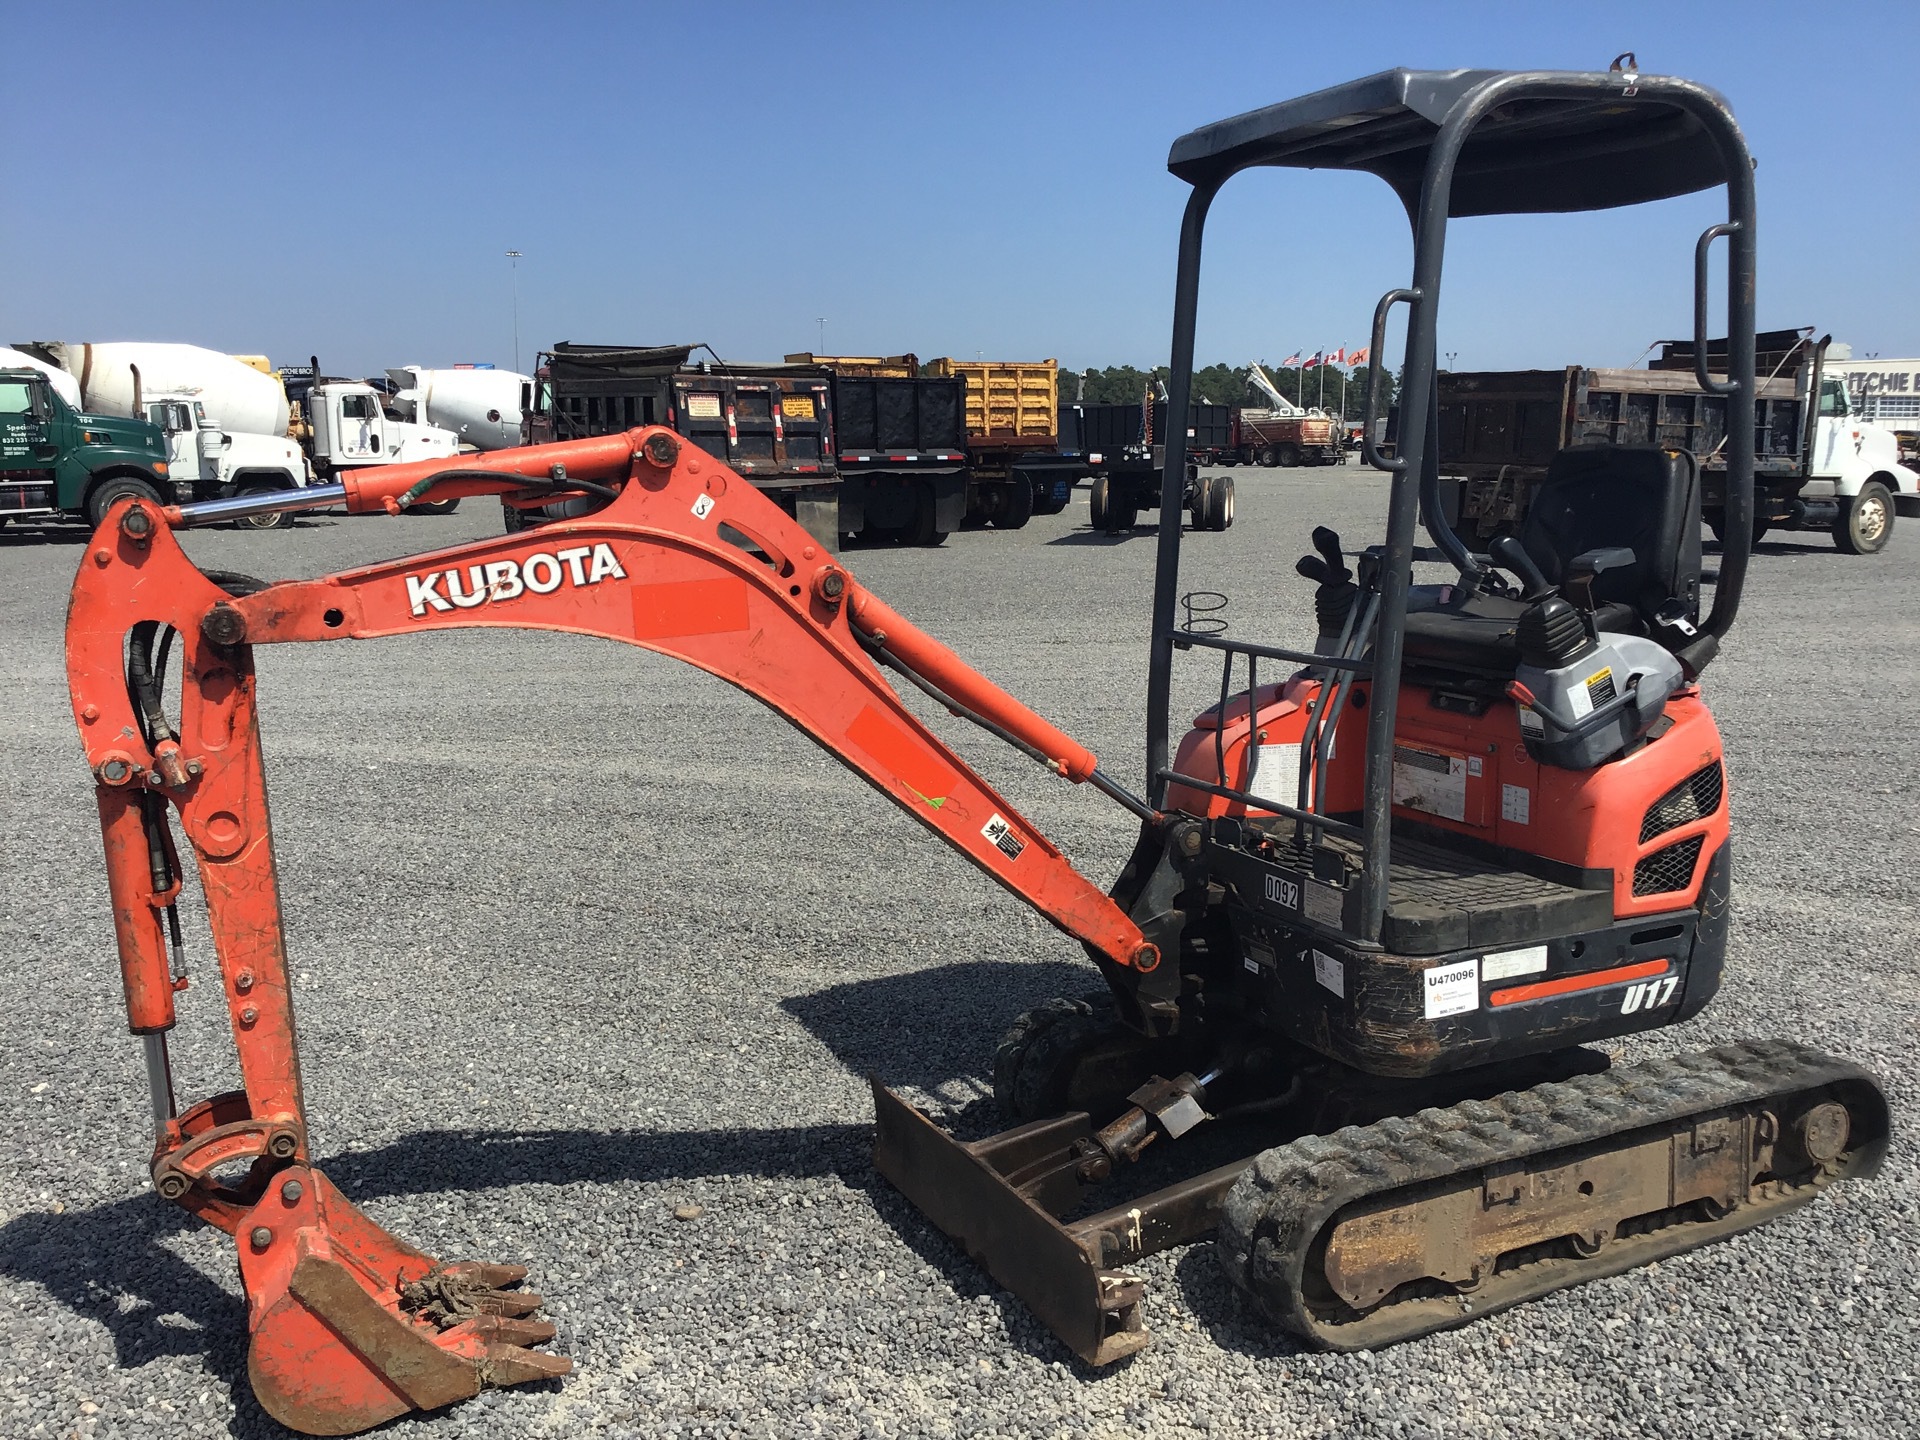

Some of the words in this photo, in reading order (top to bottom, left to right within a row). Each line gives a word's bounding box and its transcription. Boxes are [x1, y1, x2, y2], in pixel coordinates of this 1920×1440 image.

[1846, 372, 1910, 392] ITCHIE
[6, 424, 40, 432] Specialty
[404, 542, 628, 616] KUBOTA
[1266, 877, 1298, 908] 0092
[1428, 968, 1475, 987] U470096
[1620, 976, 1680, 1015] U17
